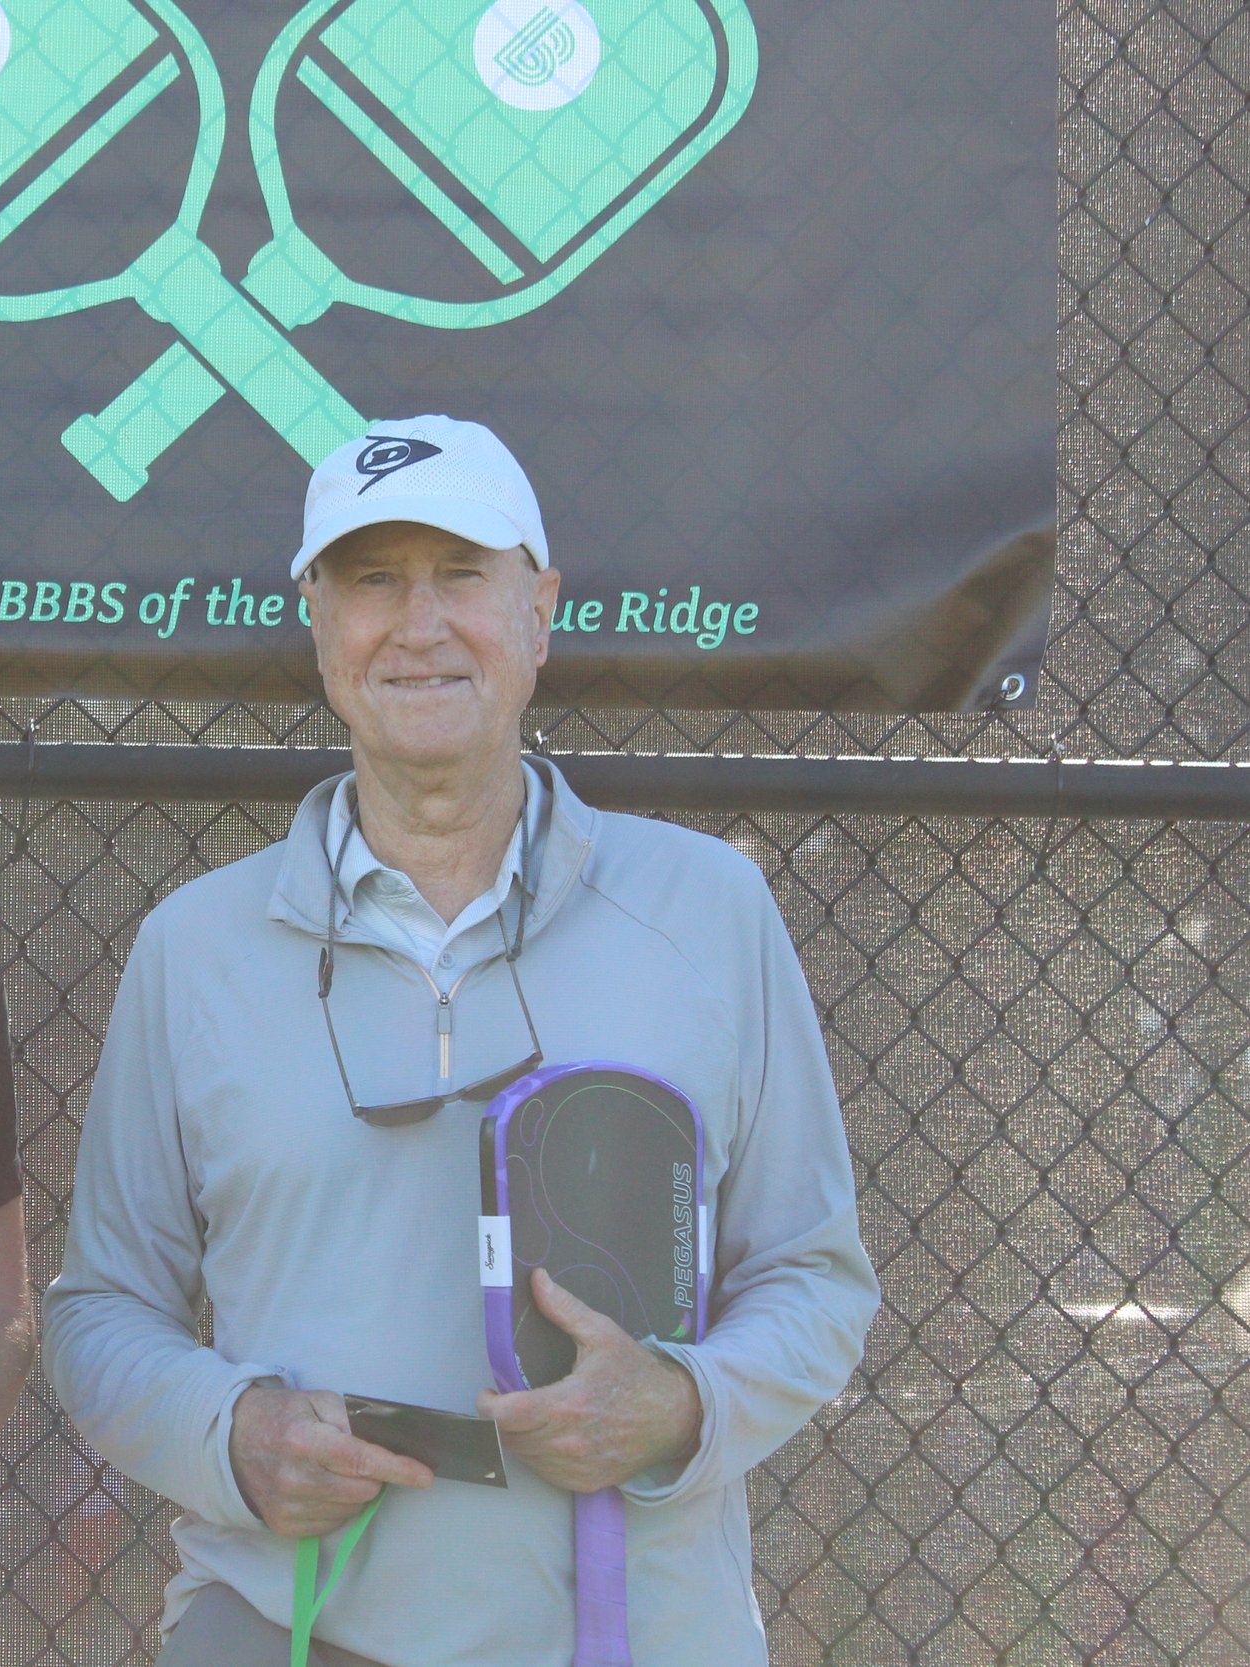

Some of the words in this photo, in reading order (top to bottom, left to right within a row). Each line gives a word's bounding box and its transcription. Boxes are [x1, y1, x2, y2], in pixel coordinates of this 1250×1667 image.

[139, 577, 195, 639] of
[206, 577, 285, 627] the
[550, 600, 604, 632] ue
[615, 586, 759, 650] Ridge
[672, 1162, 694, 1309] PEGASUS
